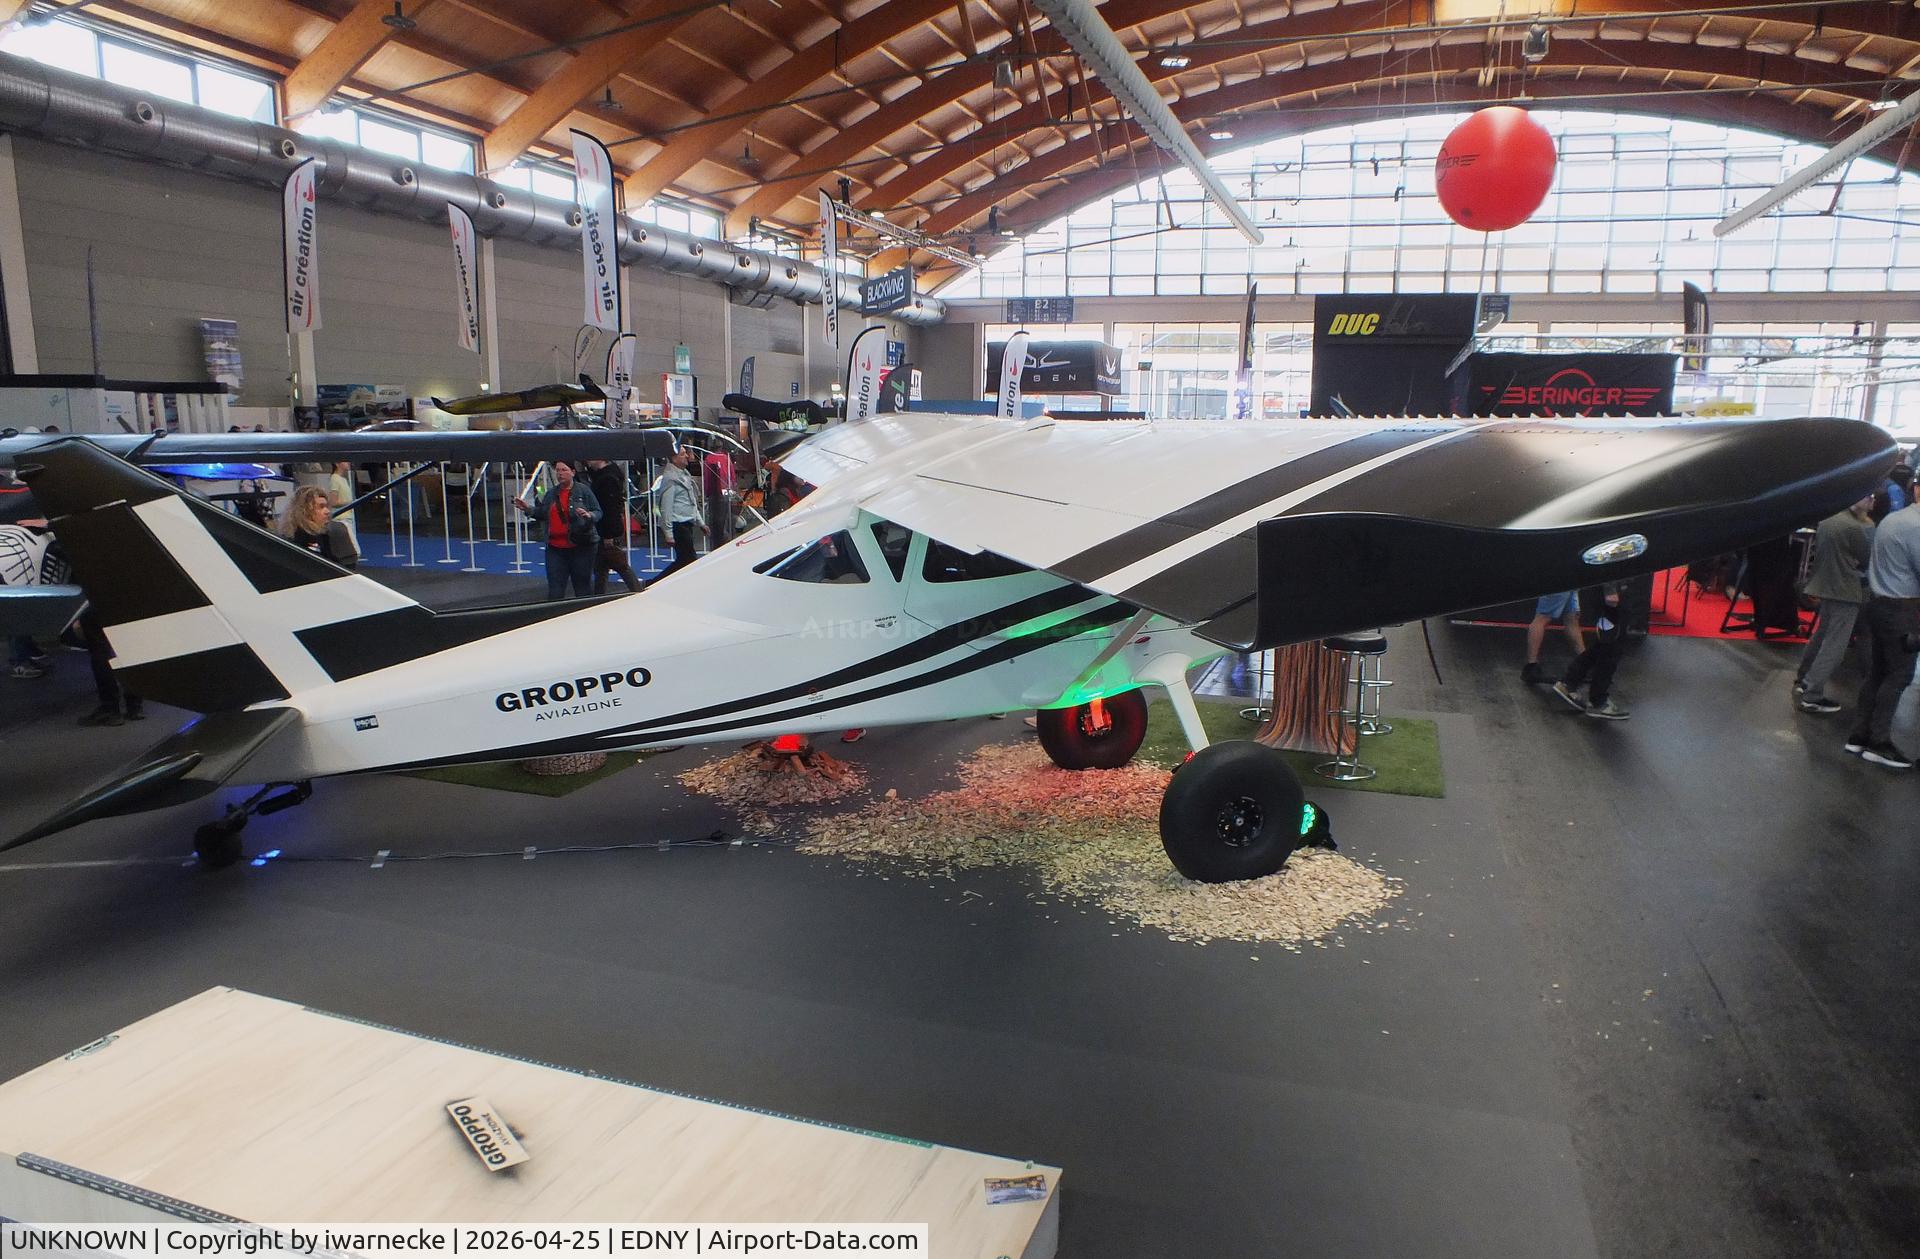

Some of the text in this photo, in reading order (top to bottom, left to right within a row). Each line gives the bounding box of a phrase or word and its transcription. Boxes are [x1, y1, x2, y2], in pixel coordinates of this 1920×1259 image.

[290, 206, 314, 317] air création
[868, 275, 904, 302] BLACKWING
[1034, 299, 1049, 309] B2
[1328, 313, 1381, 336] DUC
[858, 376, 871, 418] éation
[1006, 381, 1017, 417] ation
[1500, 386, 1622, 406] BERINGER
[495, 667, 652, 712] GROPPO
[535, 698, 623, 722] AVIAZIONE
[454, 1105, 507, 1165] GROPPO
